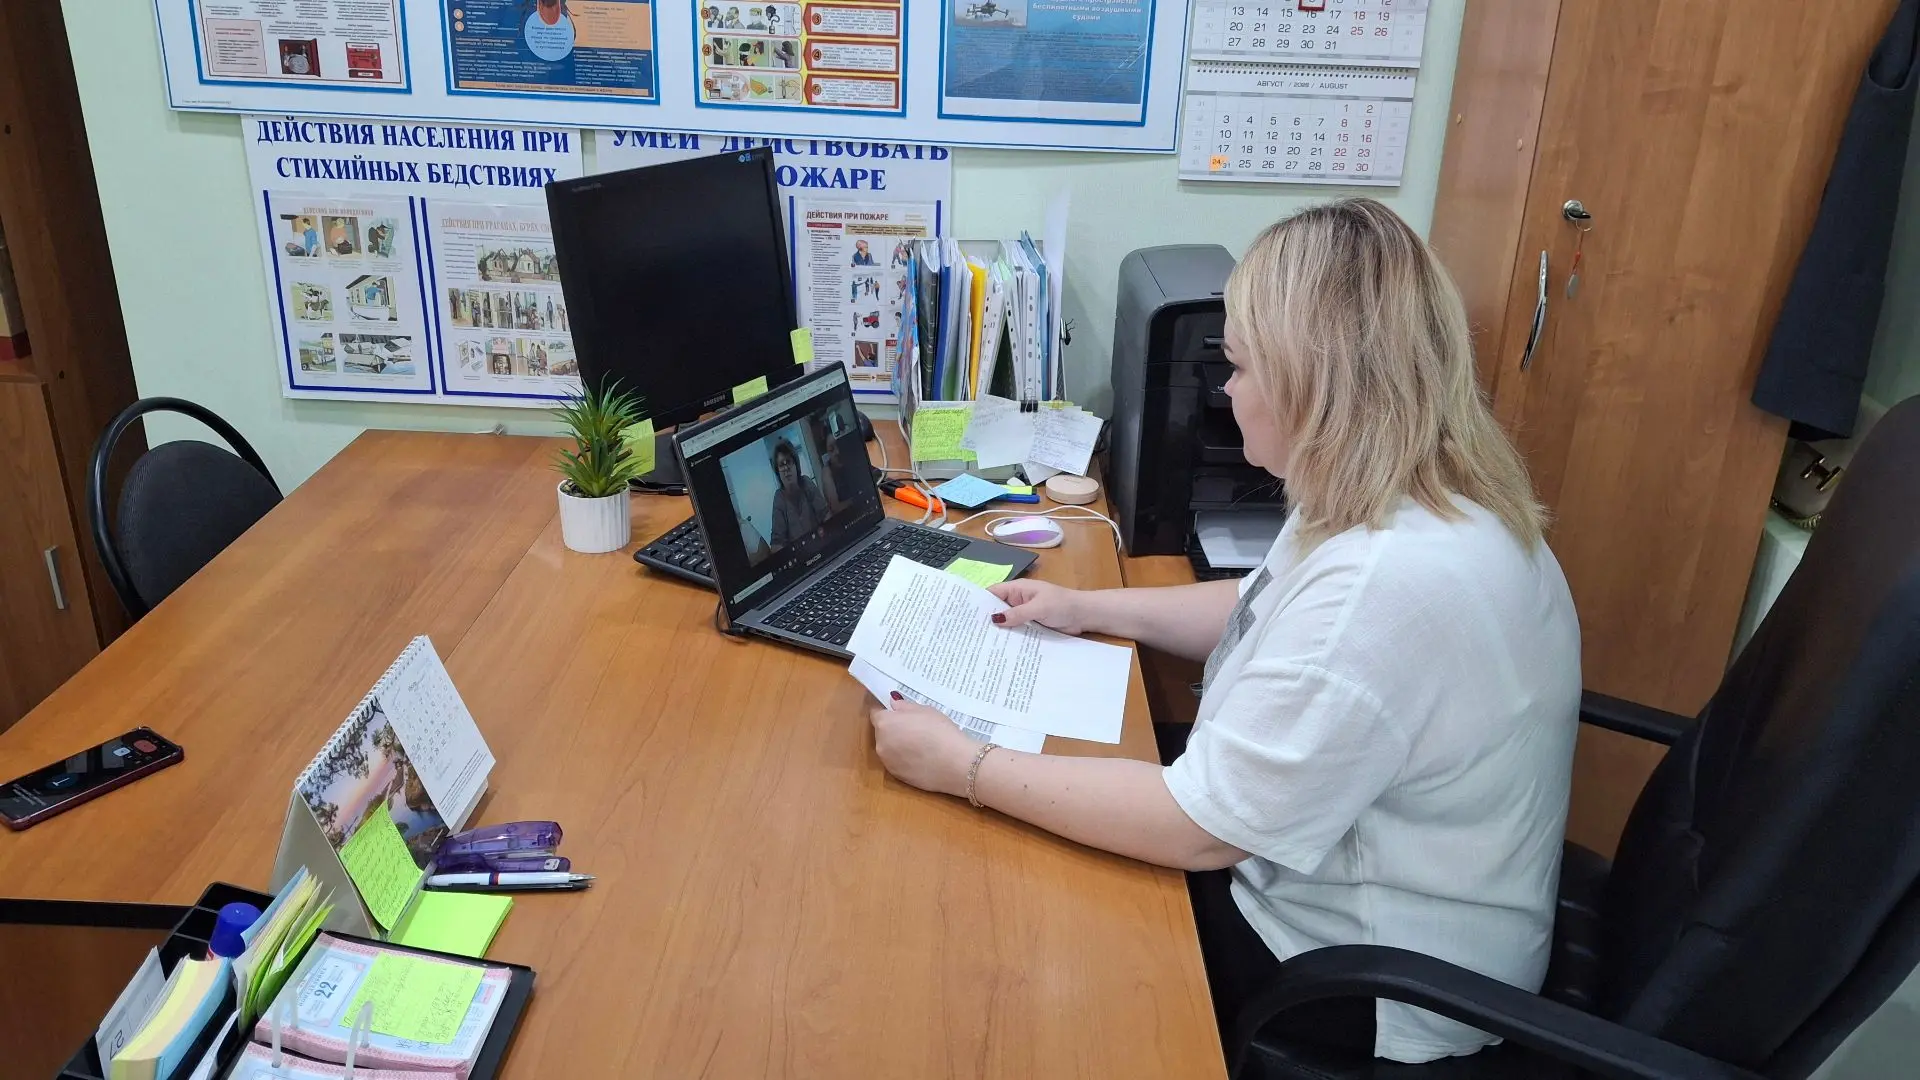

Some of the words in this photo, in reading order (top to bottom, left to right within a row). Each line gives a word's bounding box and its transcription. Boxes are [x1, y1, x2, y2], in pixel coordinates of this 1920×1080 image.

[1032, 3, 1090, 12] беспилотными
[1092, 6, 1142, 14] воздушными
[1233, 7, 1244, 15] 13
[1257, 8, 1268, 16] 14
[1281, 8, 1292, 17] 15
[1330, 10, 1341, 19] 17
[1354, 11, 1365, 20] 18
[1378, 12, 1390, 21] 19
[1230, 22, 1243, 31] 20
[1254, 23, 1265, 31] 21
[1278, 24, 1291, 32] 22
[1303, 25, 1315, 33] 23
[1327, 26, 1339, 34] 24
[1350, 27, 1363, 35] 25
[1375, 28, 1387, 36] 26
[1228, 38, 1241, 46] 27
[1253, 38, 1265, 47] 28
[1277, 39, 1289, 48] 29
[1301, 40, 1314, 48] 30
[1325, 41, 1336, 50] 31
[1344, 104, 1348, 112] 1
[1367, 105, 1373, 113] 2
[1224, 115, 1229, 123] 3
[1247, 116, 1252, 124] 4
[1271, 117, 1276, 125] 5
[1294, 118, 1300, 126] 6
[1318, 118, 1324, 126] 7
[1341, 119, 1347, 127] 8
[1365, 120, 1371, 128] 9
[257, 116, 374, 146] ДЕЙСТВИЯ
[382, 125, 515, 151] НАСЕЛЕНИЯ
[522, 130, 570, 154] ПРИ
[1220, 130, 1231, 138] 10
[1244, 131, 1253, 139] 11
[1267, 132, 1278, 140] 12
[1291, 132, 1301, 140] 13
[1314, 133, 1324, 141] 14
[1338, 134, 1348, 142] 15
[1361, 134, 1372, 142] 16
[1242, 145, 1253, 153] 18
[1265, 146, 1276, 154] 19
[1287, 147, 1300, 155] 20
[1334, 148, 1346, 156] 22
[1358, 149, 1370, 157] 23
[276, 154, 419, 182] СТИХИЙНЫХ
[427, 163, 557, 189] БЕДСТВИЯХ
[1239, 160, 1251, 168] 25
[1262, 160, 1274, 168] 26
[1285, 161, 1298, 169] 27
[1309, 162, 1321, 170] 28
[1356, 163, 1368, 171] 30
[776, 164, 887, 191] ОЖАРЕ
[806, 210, 842, 220] ДЕЙСТВИЯ
[844, 212, 858, 220] ПРИ
[860, 212, 888, 221] ПОЖАРЕ
[441, 217, 472, 228] ДЕЙСТВИЯ
[472, 220, 484, 229] ПРИ
[313, 980, 338, 1000] 22
